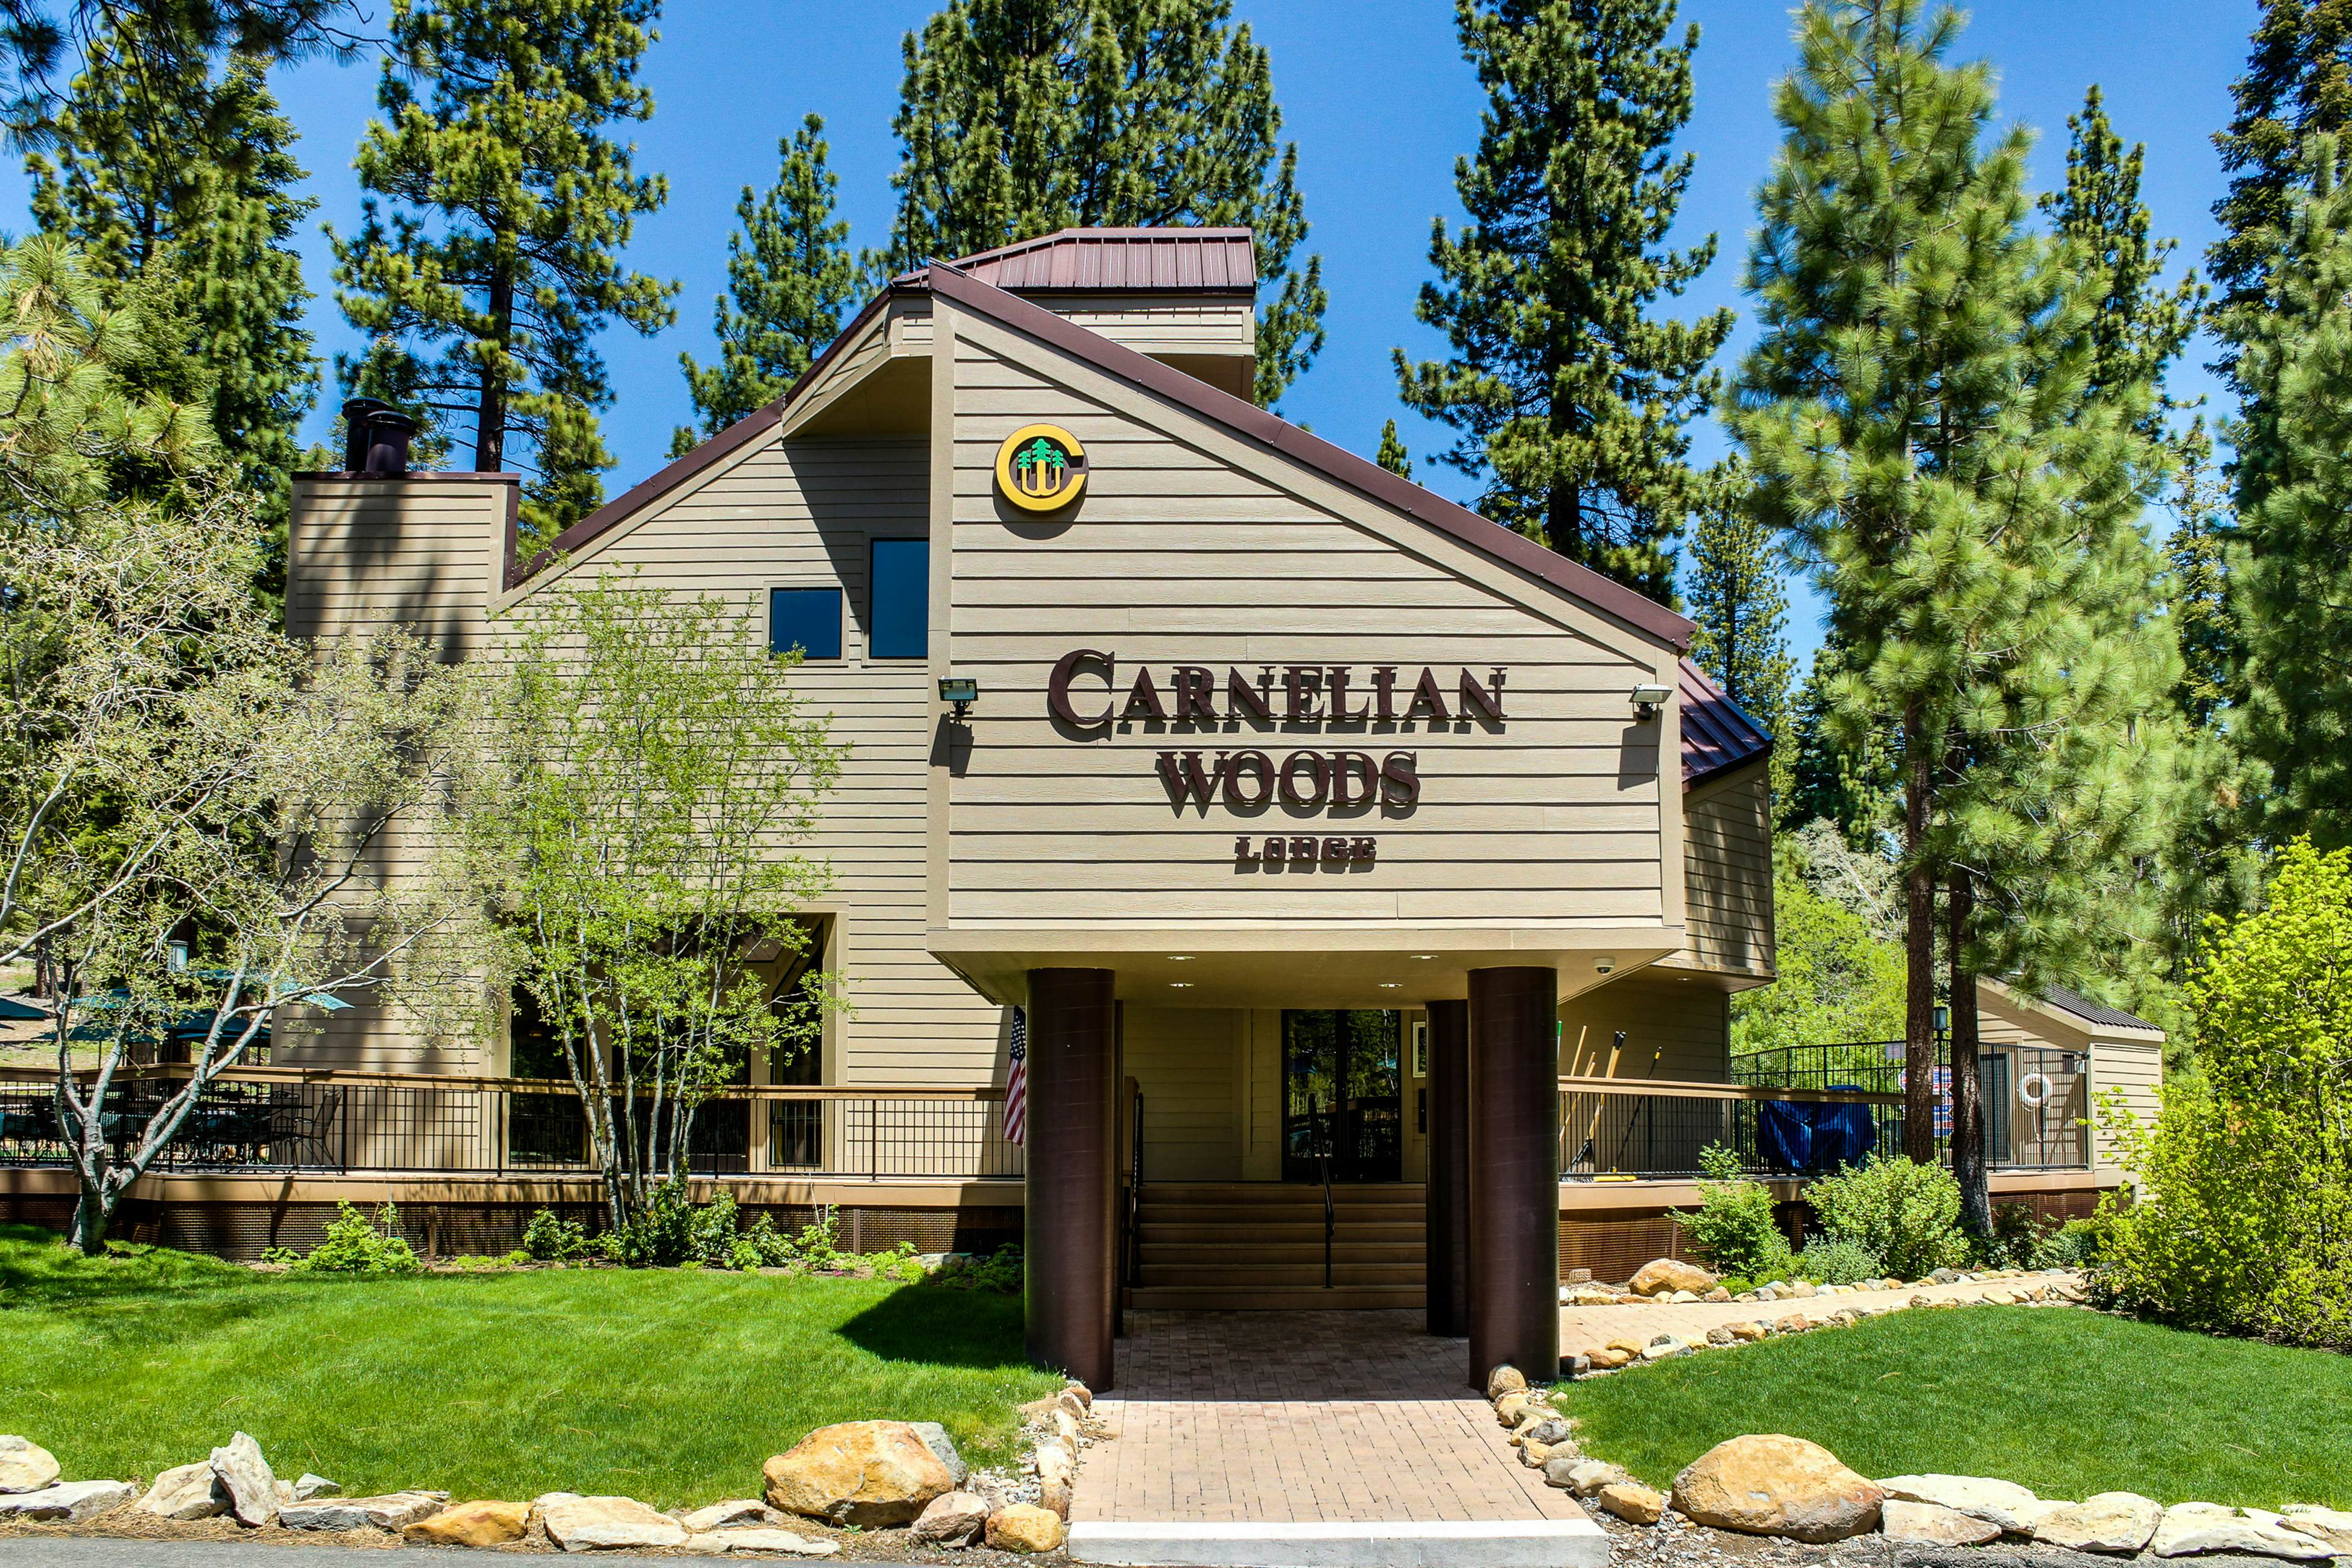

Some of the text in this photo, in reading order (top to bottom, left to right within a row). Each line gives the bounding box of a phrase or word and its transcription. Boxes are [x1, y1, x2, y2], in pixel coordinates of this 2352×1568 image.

[1048, 648, 1508, 725] CARNELIAN
[1157, 750, 1420, 803] WOODS
[1236, 836, 1377, 859] LODGE
